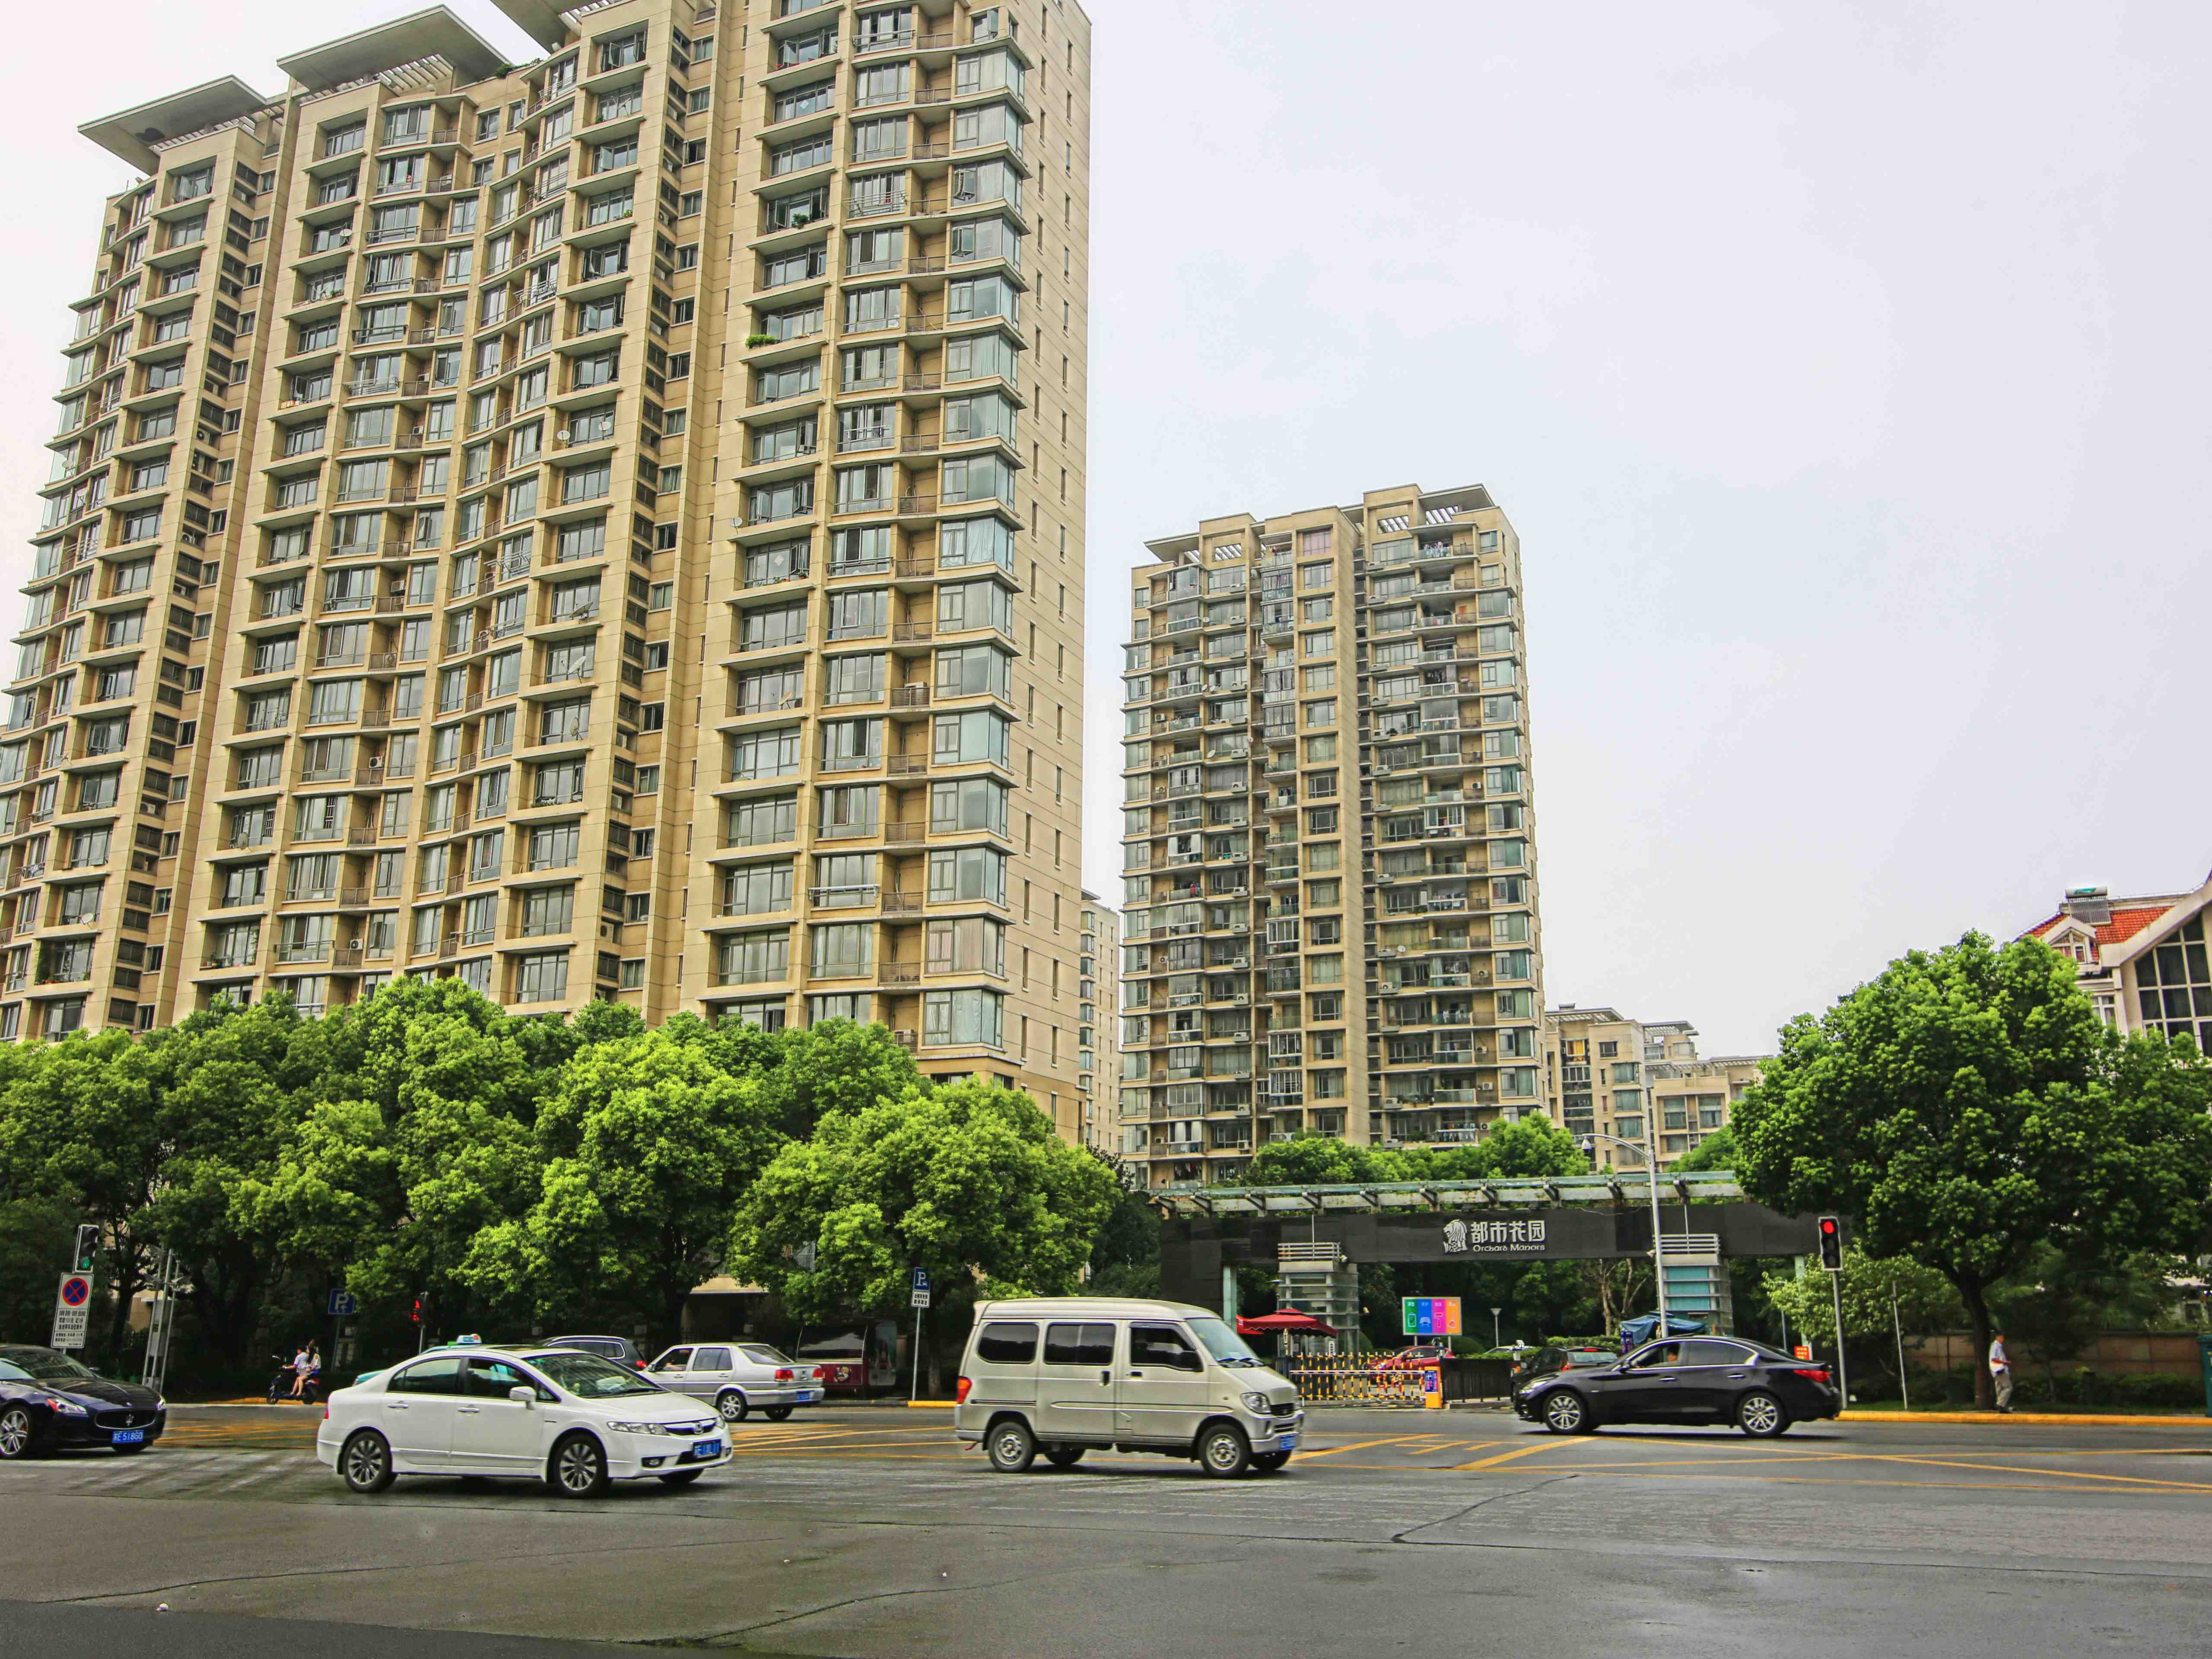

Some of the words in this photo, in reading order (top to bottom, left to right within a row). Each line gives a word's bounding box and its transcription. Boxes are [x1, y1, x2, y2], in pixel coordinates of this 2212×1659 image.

[1471, 1220, 1545, 1243] 都市花园
[916, 1272, 926, 1286] P
[335, 1294, 349, 1310] P
